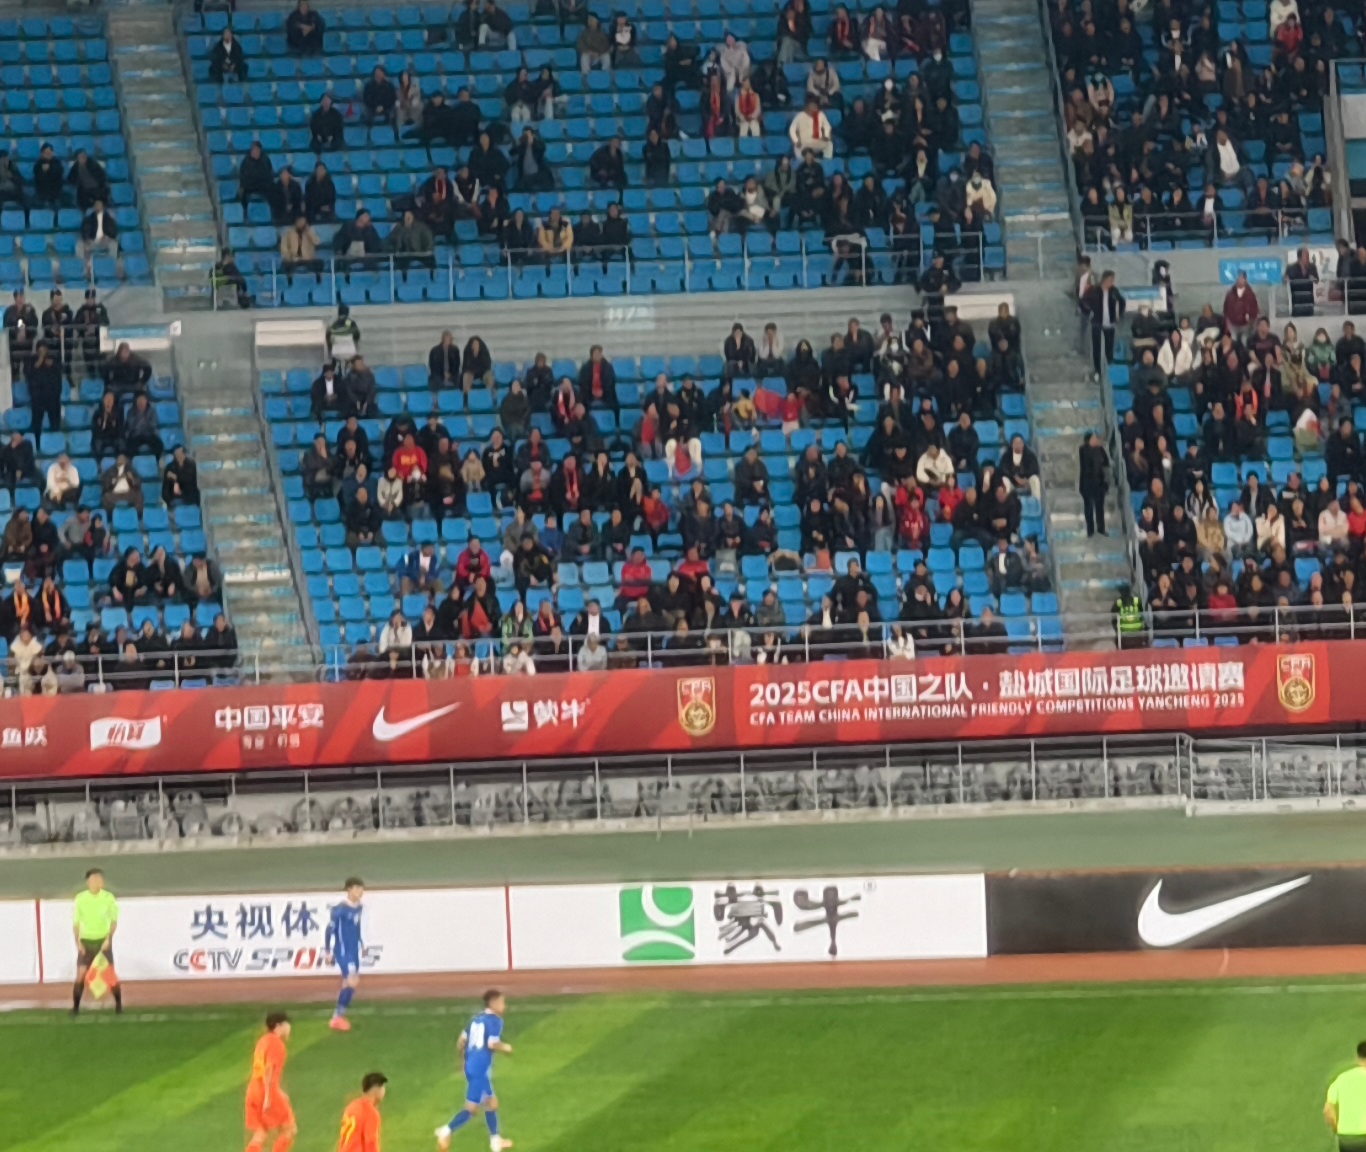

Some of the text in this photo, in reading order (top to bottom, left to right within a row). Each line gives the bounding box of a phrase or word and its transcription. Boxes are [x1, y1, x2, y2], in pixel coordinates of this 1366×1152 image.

[819, 707, 860, 722] CHINA
[865, 704, 967, 721] INTERNATIONAL
[971, 700, 1032, 717] FRIENDLY
[191, 901, 337, 940] 央视体
[713, 883, 862, 955] 蒙牛
[173, 944, 383, 971] CCTV SPOS
